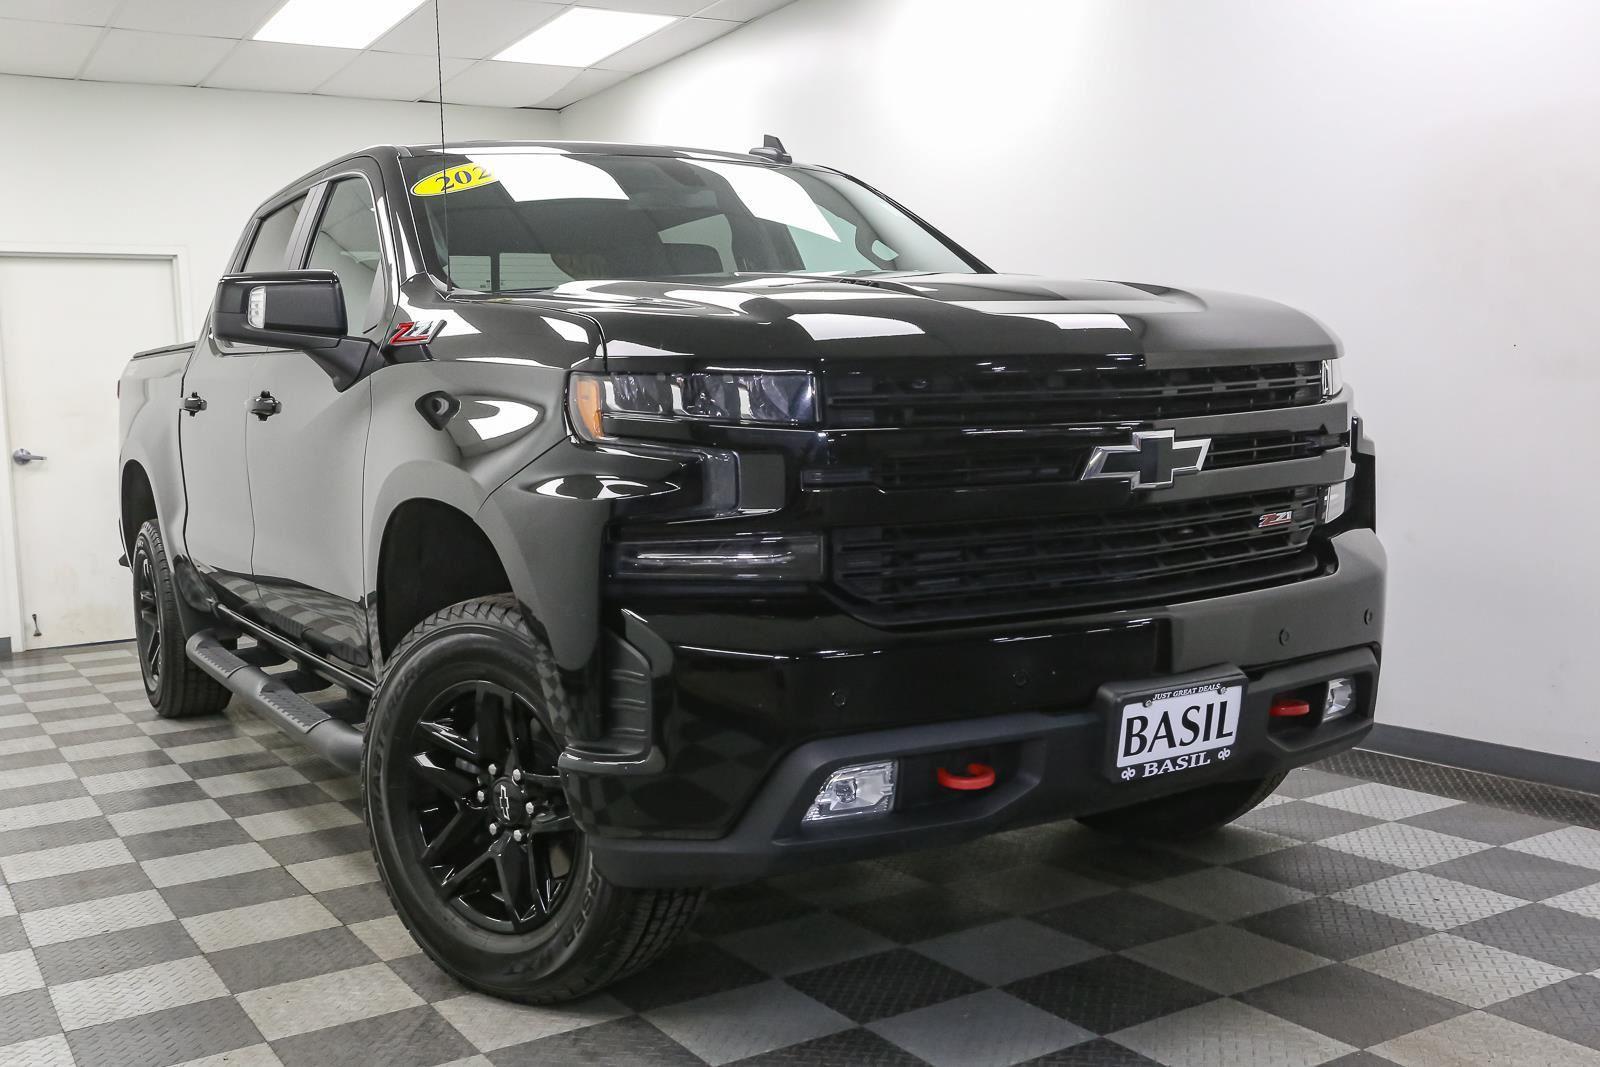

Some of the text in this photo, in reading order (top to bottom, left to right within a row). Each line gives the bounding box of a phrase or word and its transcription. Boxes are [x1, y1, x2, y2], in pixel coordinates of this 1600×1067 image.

[435, 166, 492, 191] 202
[1258, 511, 1292, 528] Z71
[1152, 683, 1220, 701] JUST GREAT DEALS
[1123, 700, 1233, 758] BASIL
[1142, 752, 1211, 778] BASIL
